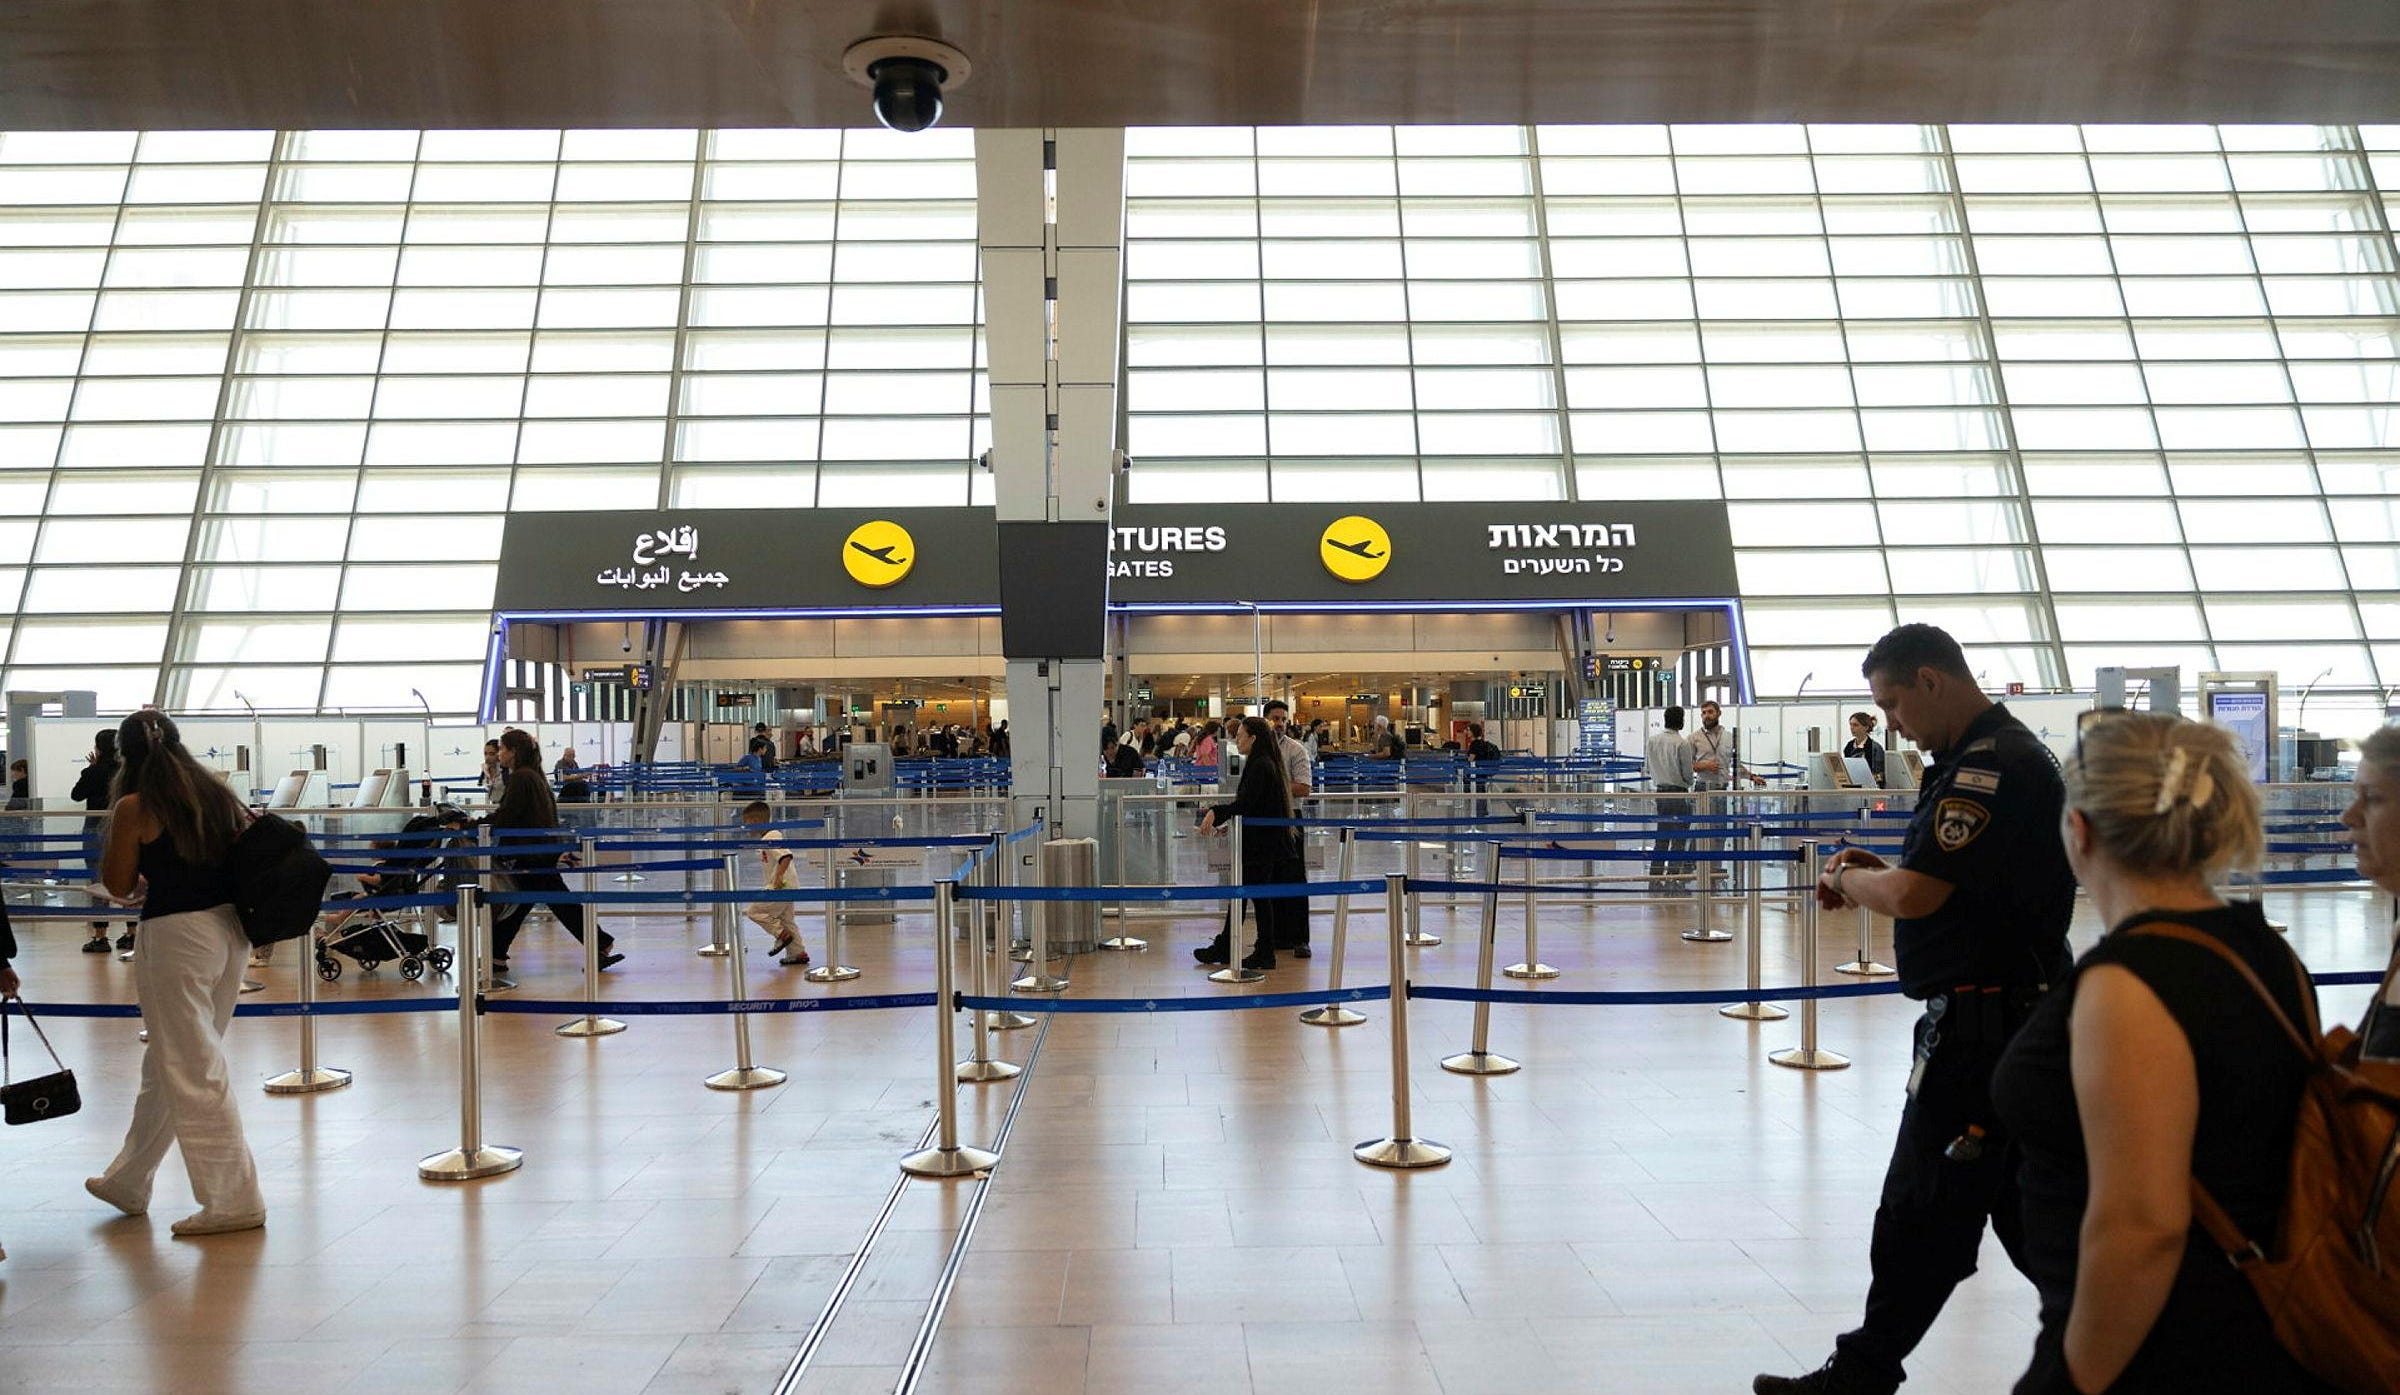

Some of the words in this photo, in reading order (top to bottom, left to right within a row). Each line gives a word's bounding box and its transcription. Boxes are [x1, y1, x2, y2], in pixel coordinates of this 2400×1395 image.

[633, 525, 699, 565] إقلاع
[1488, 523, 1636, 548] המראות
[1504, 557, 1591, 575] השערים
[1596, 554, 1624, 573] כל
[597, 565, 670, 590] البوابات
[678, 570, 729, 592] جميع
[728, 1001, 775, 1012] SECURITY
